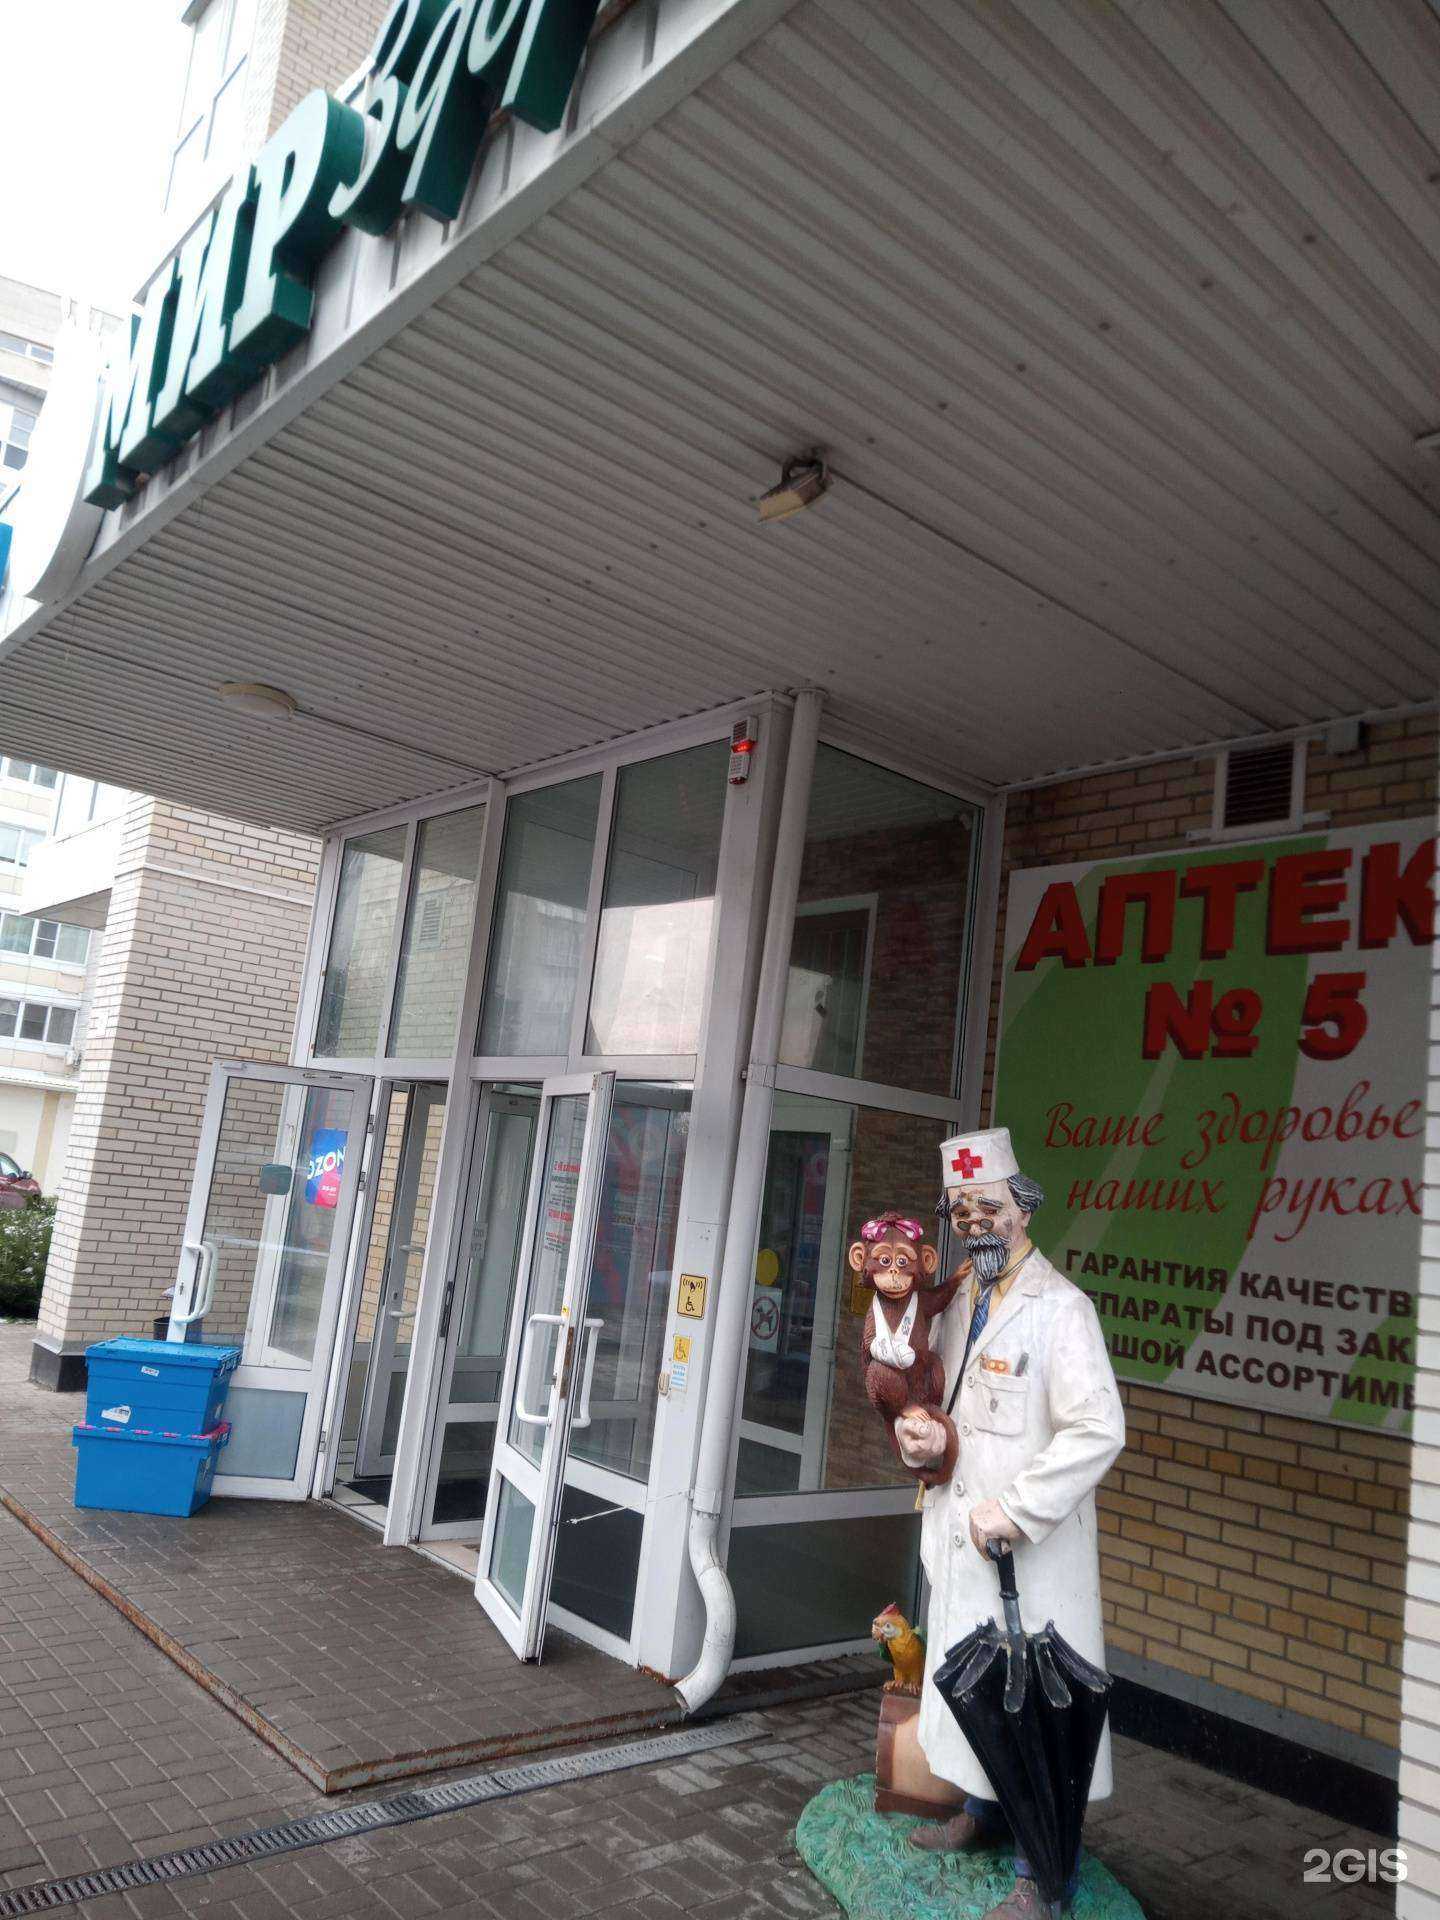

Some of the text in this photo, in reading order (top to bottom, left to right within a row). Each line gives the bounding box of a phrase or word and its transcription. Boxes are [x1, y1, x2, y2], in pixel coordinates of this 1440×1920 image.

[84, 88, 350, 508] МИР
[1142, 971, 1368, 1062] № 5
[1043, 1080, 1424, 1172] Ваше здоровье
[1066, 1174, 1424, 1241] наших руках
[1065, 1249, 1228, 1293] ГАРАНТИЯ
[1106, 1333, 1184, 1369] ШОЙ
[1246, 1315, 1325, 1356] ПОД
